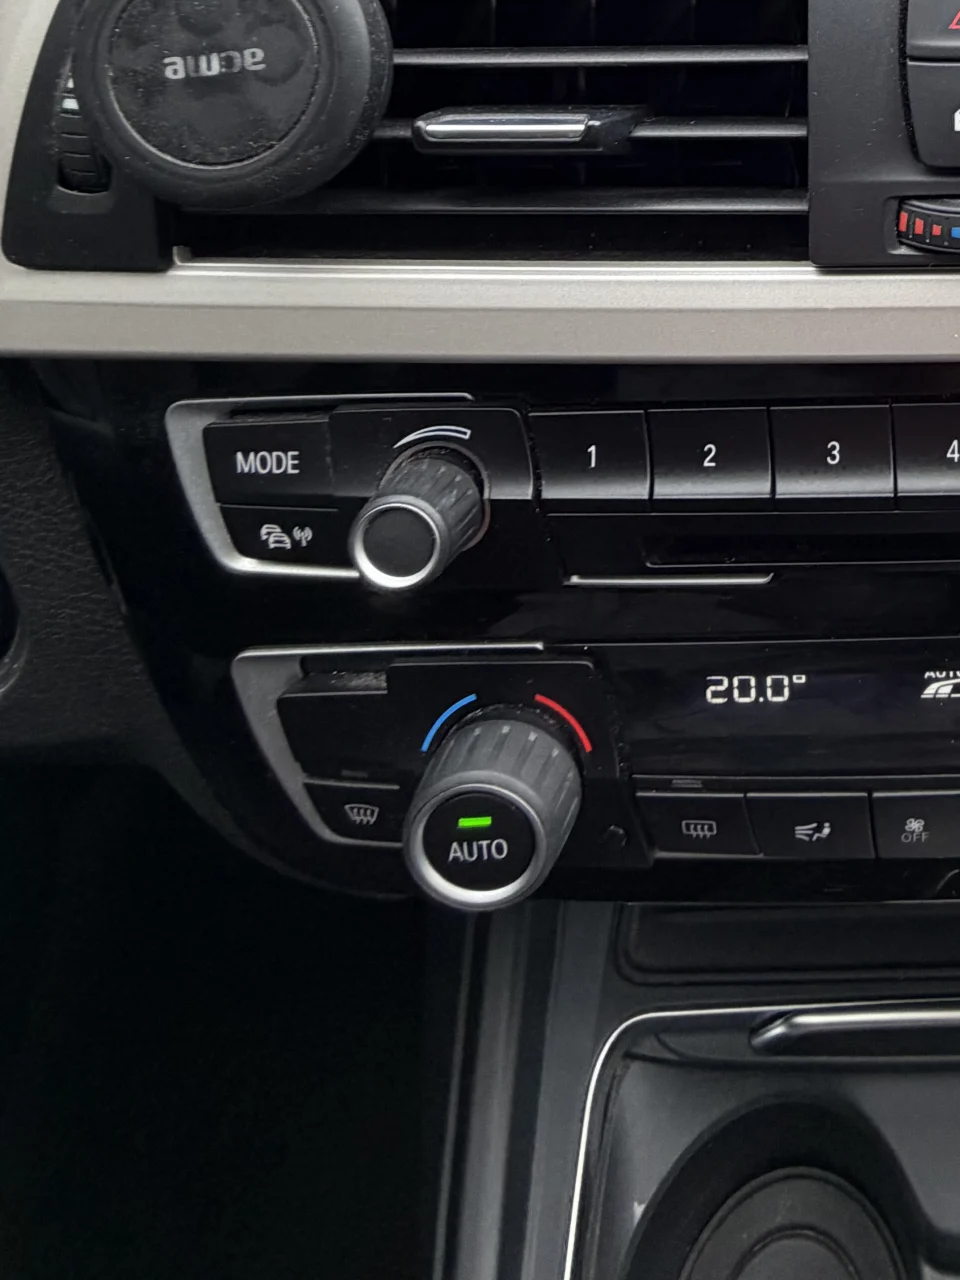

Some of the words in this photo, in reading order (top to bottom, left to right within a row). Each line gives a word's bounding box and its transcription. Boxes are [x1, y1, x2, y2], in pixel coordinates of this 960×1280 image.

[236, 450, 300, 475] MODE
[587, 444, 596, 468] 1
[703, 443, 717, 467] 2
[826, 440, 840, 465] 3
[946, 439, 960, 463] 4
[448, 838, 508, 862] AUTO
